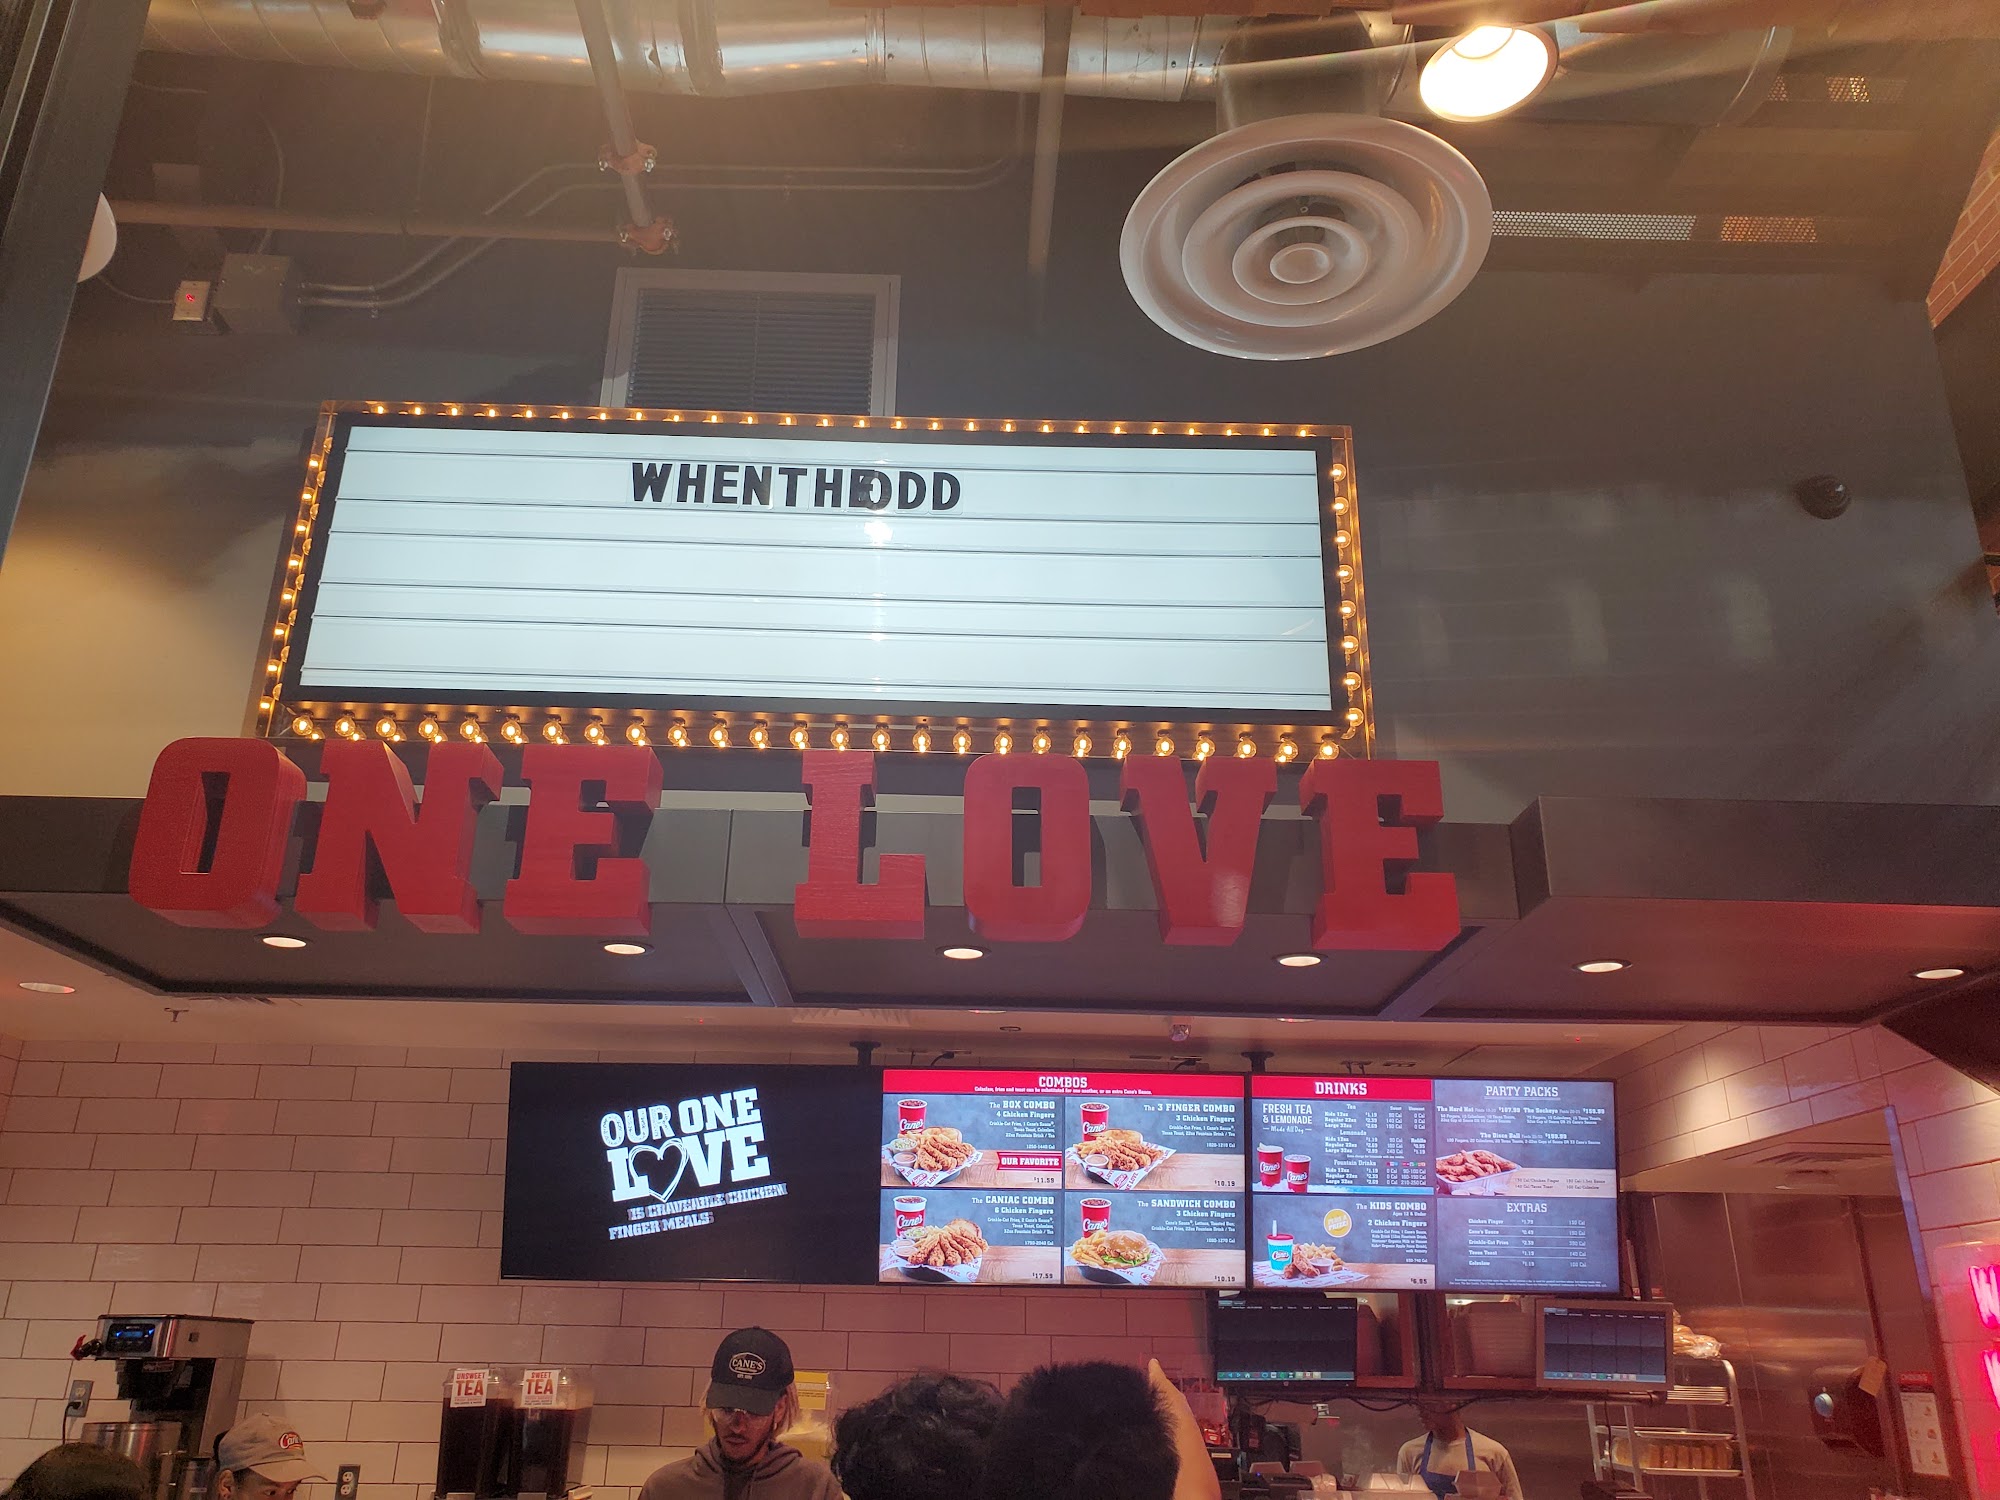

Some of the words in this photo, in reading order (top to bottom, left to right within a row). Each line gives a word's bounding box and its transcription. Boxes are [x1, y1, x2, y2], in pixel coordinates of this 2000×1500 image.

[128, 737, 664, 935] ONE
[795, 750, 1461, 950] LOVE
[1039, 1076, 1087, 1088] COMBOS
[1315, 1082, 1368, 1095] DRINKS
[1486, 1086, 1521, 1096] PARTY
[1524, 1086, 1559, 1097] PACKS
[1024, 1101, 1055, 1109] COMBO
[1166, 1104, 1200, 1112] FINGER
[1203, 1104, 1235, 1113] COMBO
[1263, 1104, 1292, 1114] FRESH
[1295, 1104, 1312, 1114] TEA
[600, 1105, 674, 1147] OUR
[678, 1088, 761, 1135] ONE
[1030, 1111, 1055, 1119] Fingers
[1209, 1115, 1235, 1123] Fingers
[1263, 1115, 1270, 1124] &
[1271, 1115, 1312, 1124] LEMONADE
[1001, 1157, 1018, 1166] OUR
[1020, 1157, 1059, 1166] FAVORITE
[985, 1195, 1020, 1204] CANIAC
[1022, 1196, 1054, 1205] COMBO
[1151, 1199, 1201, 1208] SANDWICH
[1204, 1200, 1235, 1208] COMBO
[1370, 1202, 1392, 1210] KIDS
[1395, 1202, 1426, 1210] COMBO
[1506, 1203, 1548, 1213] EXTRAS
[609, 1220, 661, 1240] FINGER
[732, 1359, 763, 1371] CANE'S
[456, 1380, 483, 1396] TEA
[526, 1379, 553, 1394] TEA
